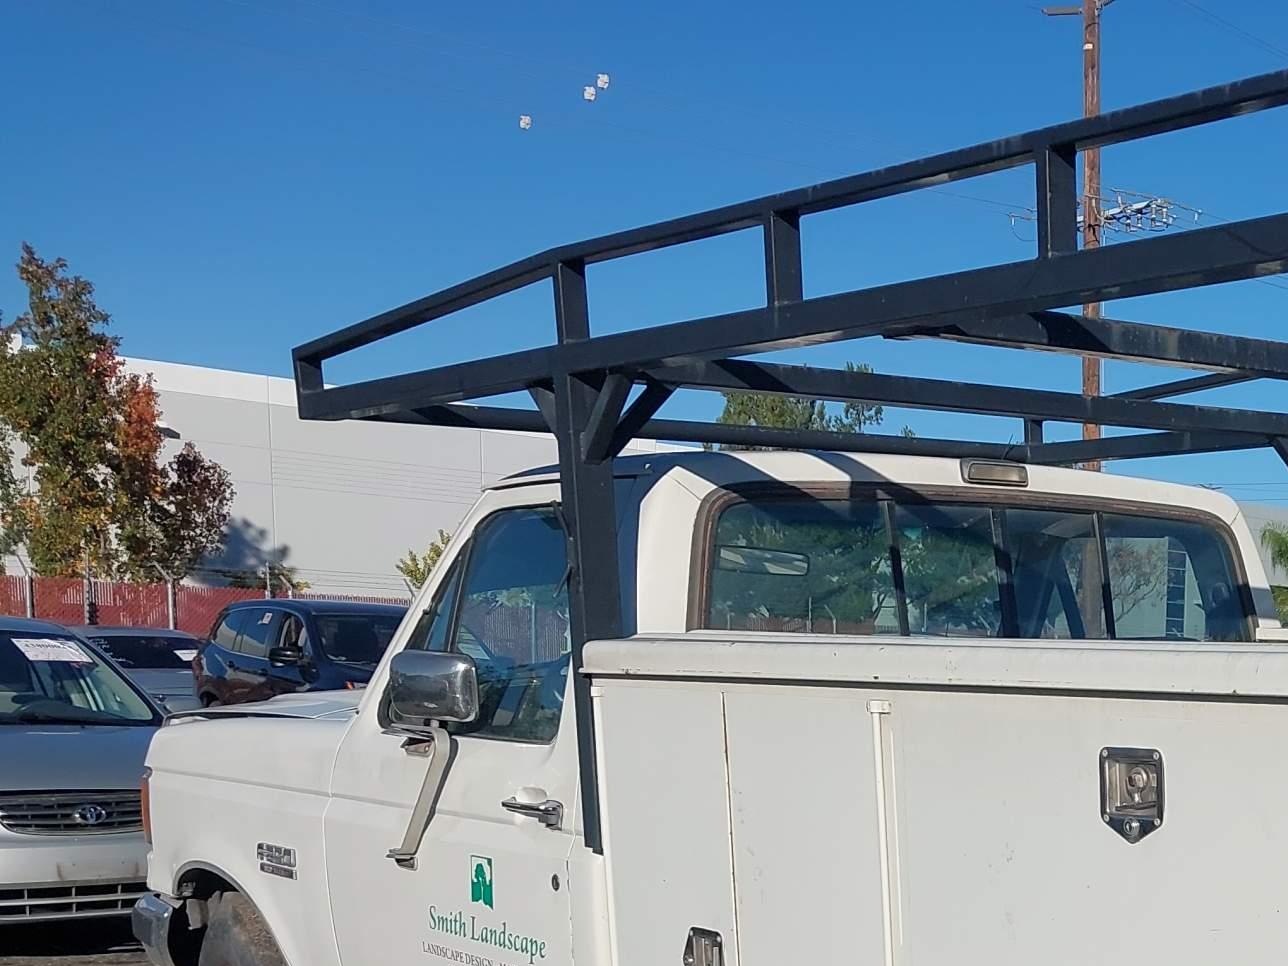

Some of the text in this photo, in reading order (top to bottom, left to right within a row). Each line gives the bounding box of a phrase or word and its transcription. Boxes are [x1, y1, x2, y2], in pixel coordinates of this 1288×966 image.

[422, 941, 465, 963] LANDSCAPE
[429, 905, 546, 965] Smith Landscape
